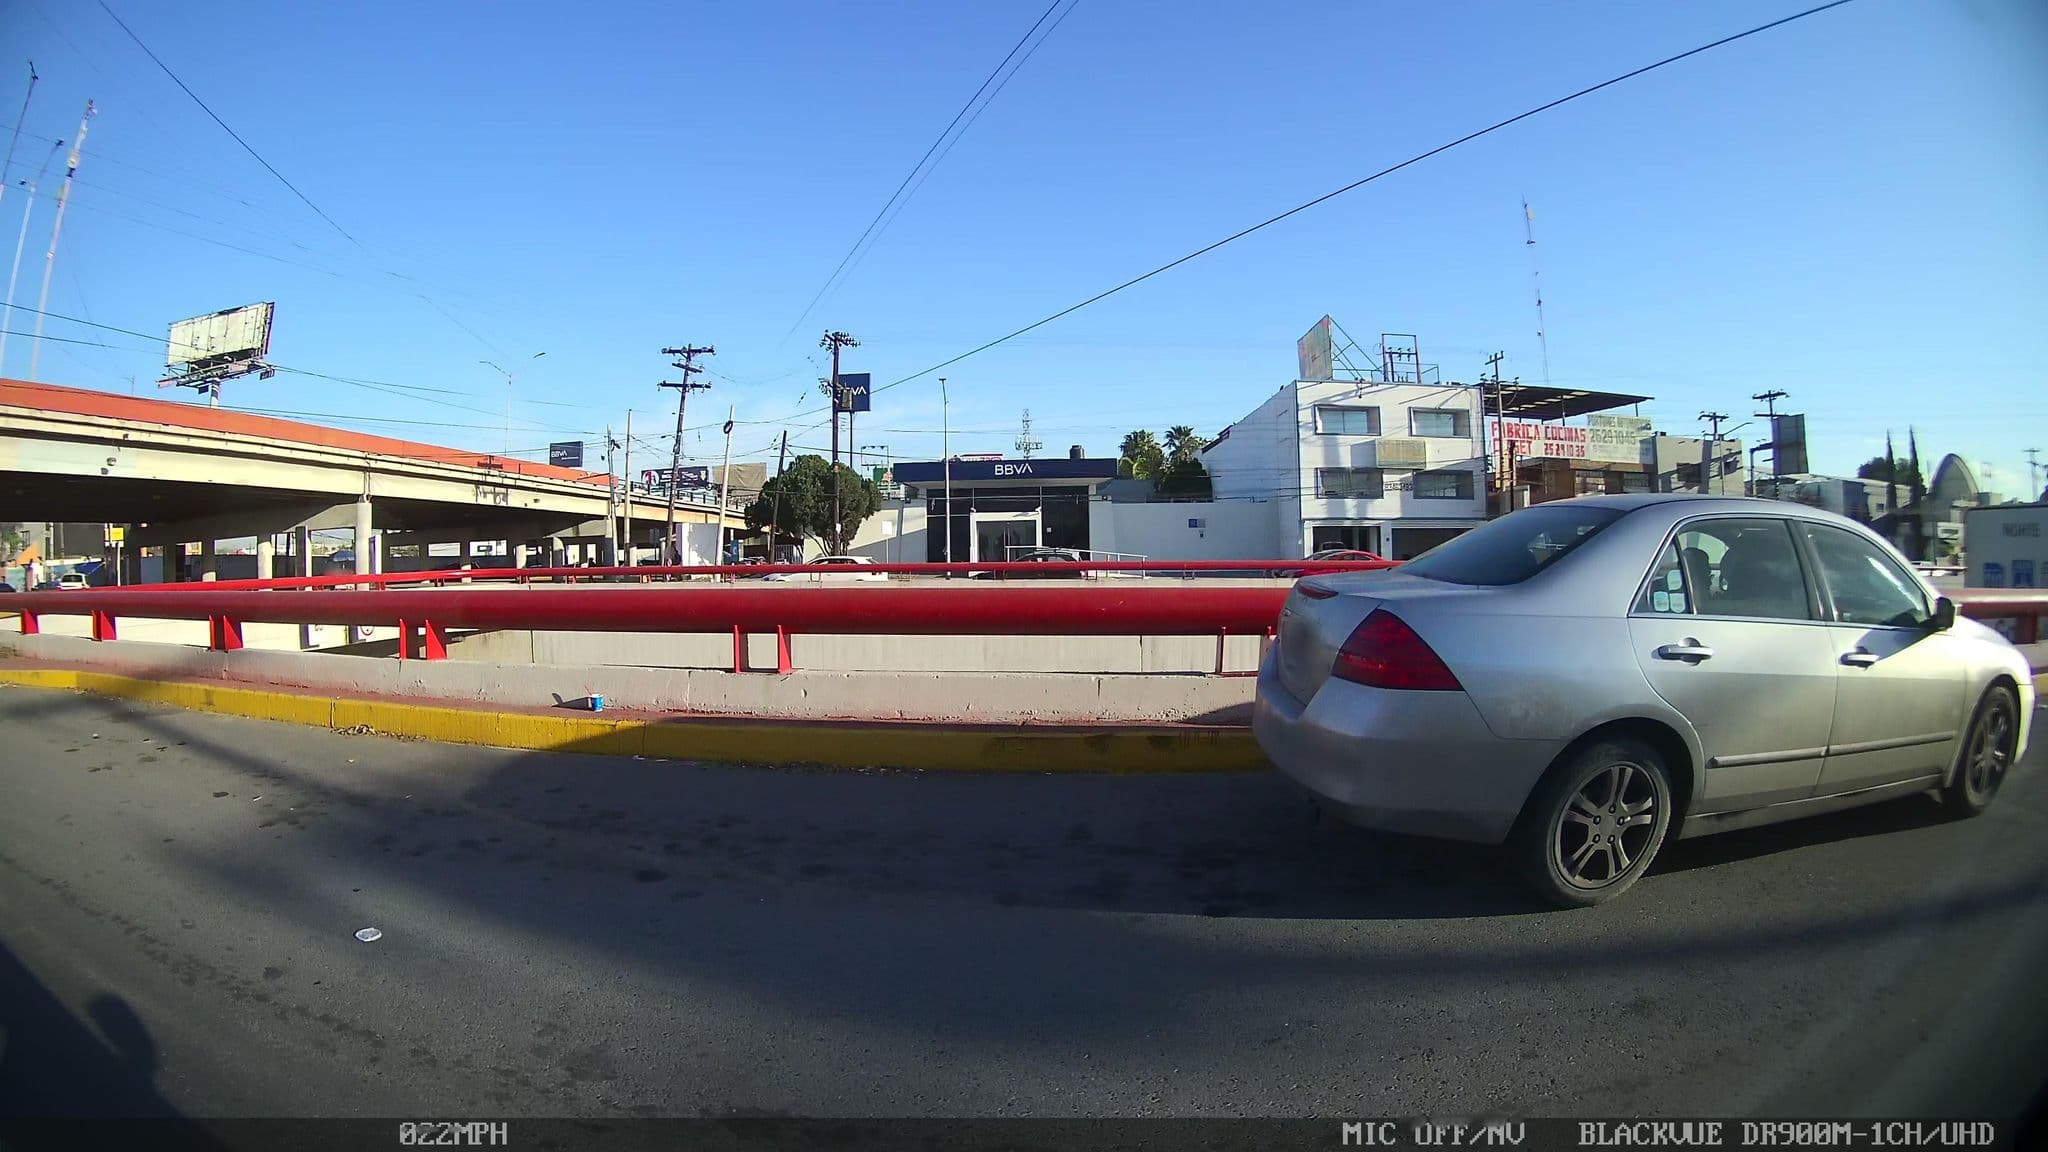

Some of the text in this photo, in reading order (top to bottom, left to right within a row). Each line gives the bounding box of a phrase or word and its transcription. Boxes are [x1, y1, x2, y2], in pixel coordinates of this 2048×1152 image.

[1544, 426, 1586, 443] COCINAS
[551, 450, 568, 458] BBVA
[994, 462, 1033, 476] BBVA
